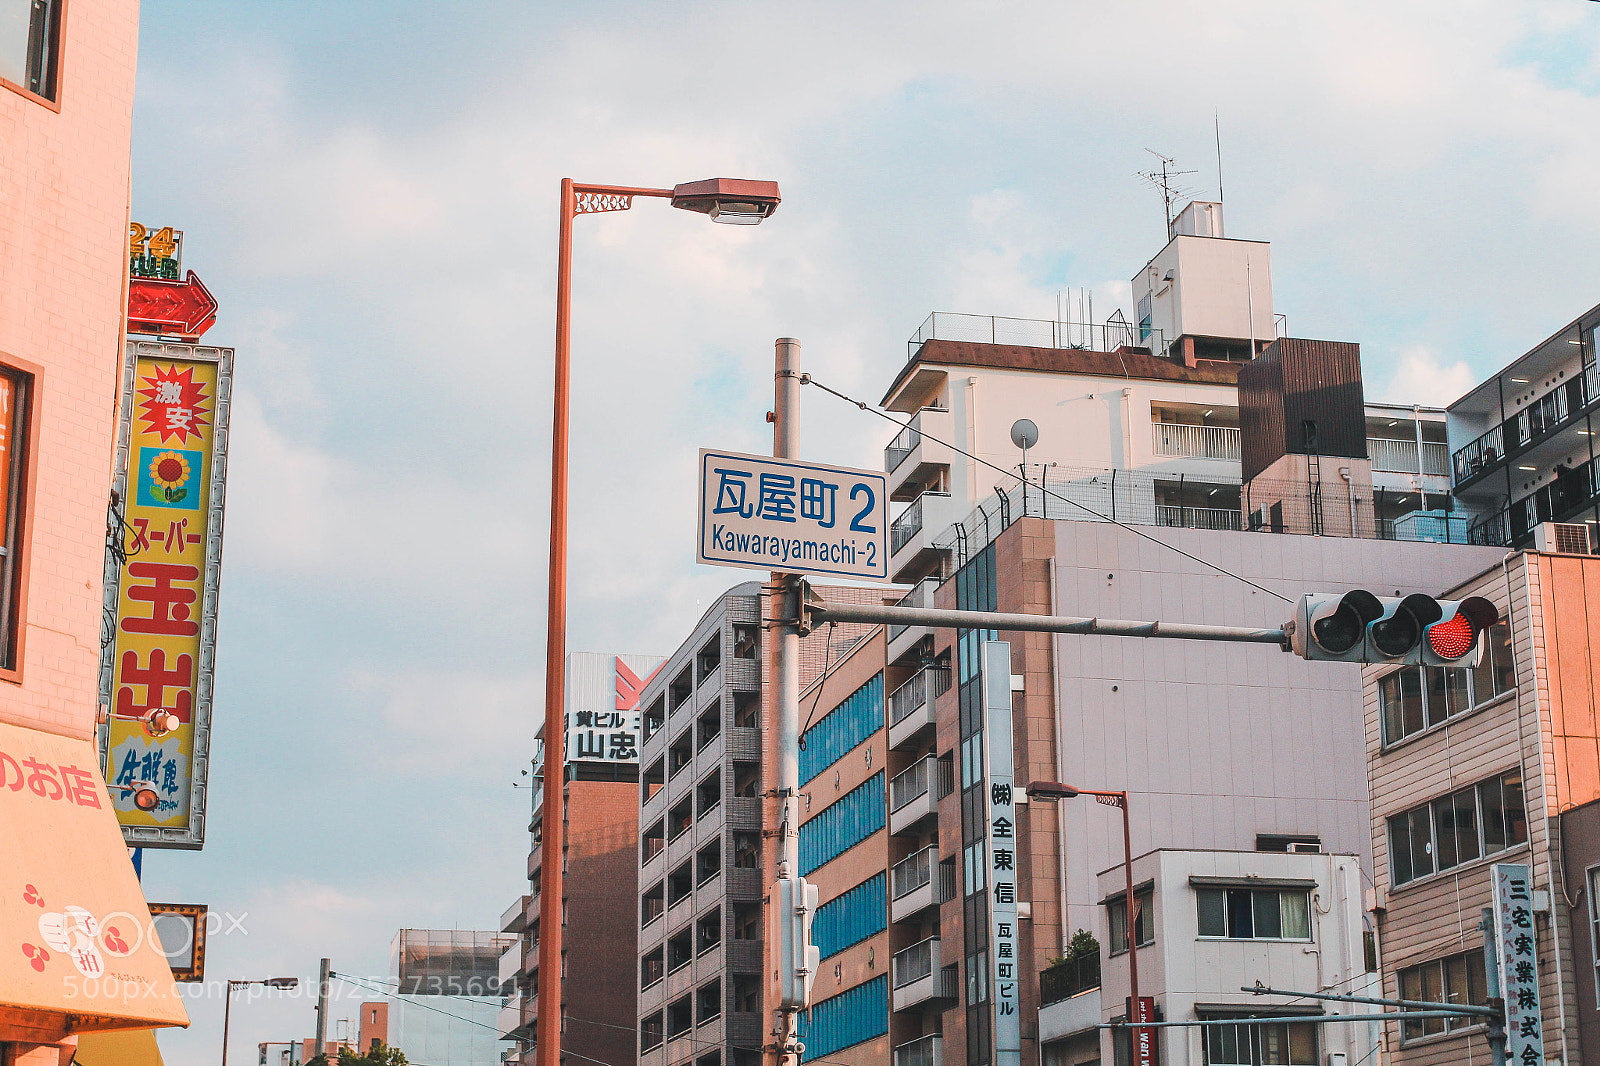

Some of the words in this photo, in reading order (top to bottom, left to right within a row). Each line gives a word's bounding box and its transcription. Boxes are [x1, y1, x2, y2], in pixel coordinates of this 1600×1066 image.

[130, 221, 176, 257] 24
[155, 380, 193, 431] 激安
[712, 468, 839, 528] 瓦屋町
[850, 483, 876, 534] 2
[130, 517, 201, 554] スーパー
[712, 523, 877, 567] Kawarayamachi-2
[116, 561, 200, 724] 玉出
[577, 730, 638, 759] 山忠
[997, 922, 1014, 1016] 瓦屋町ビル
